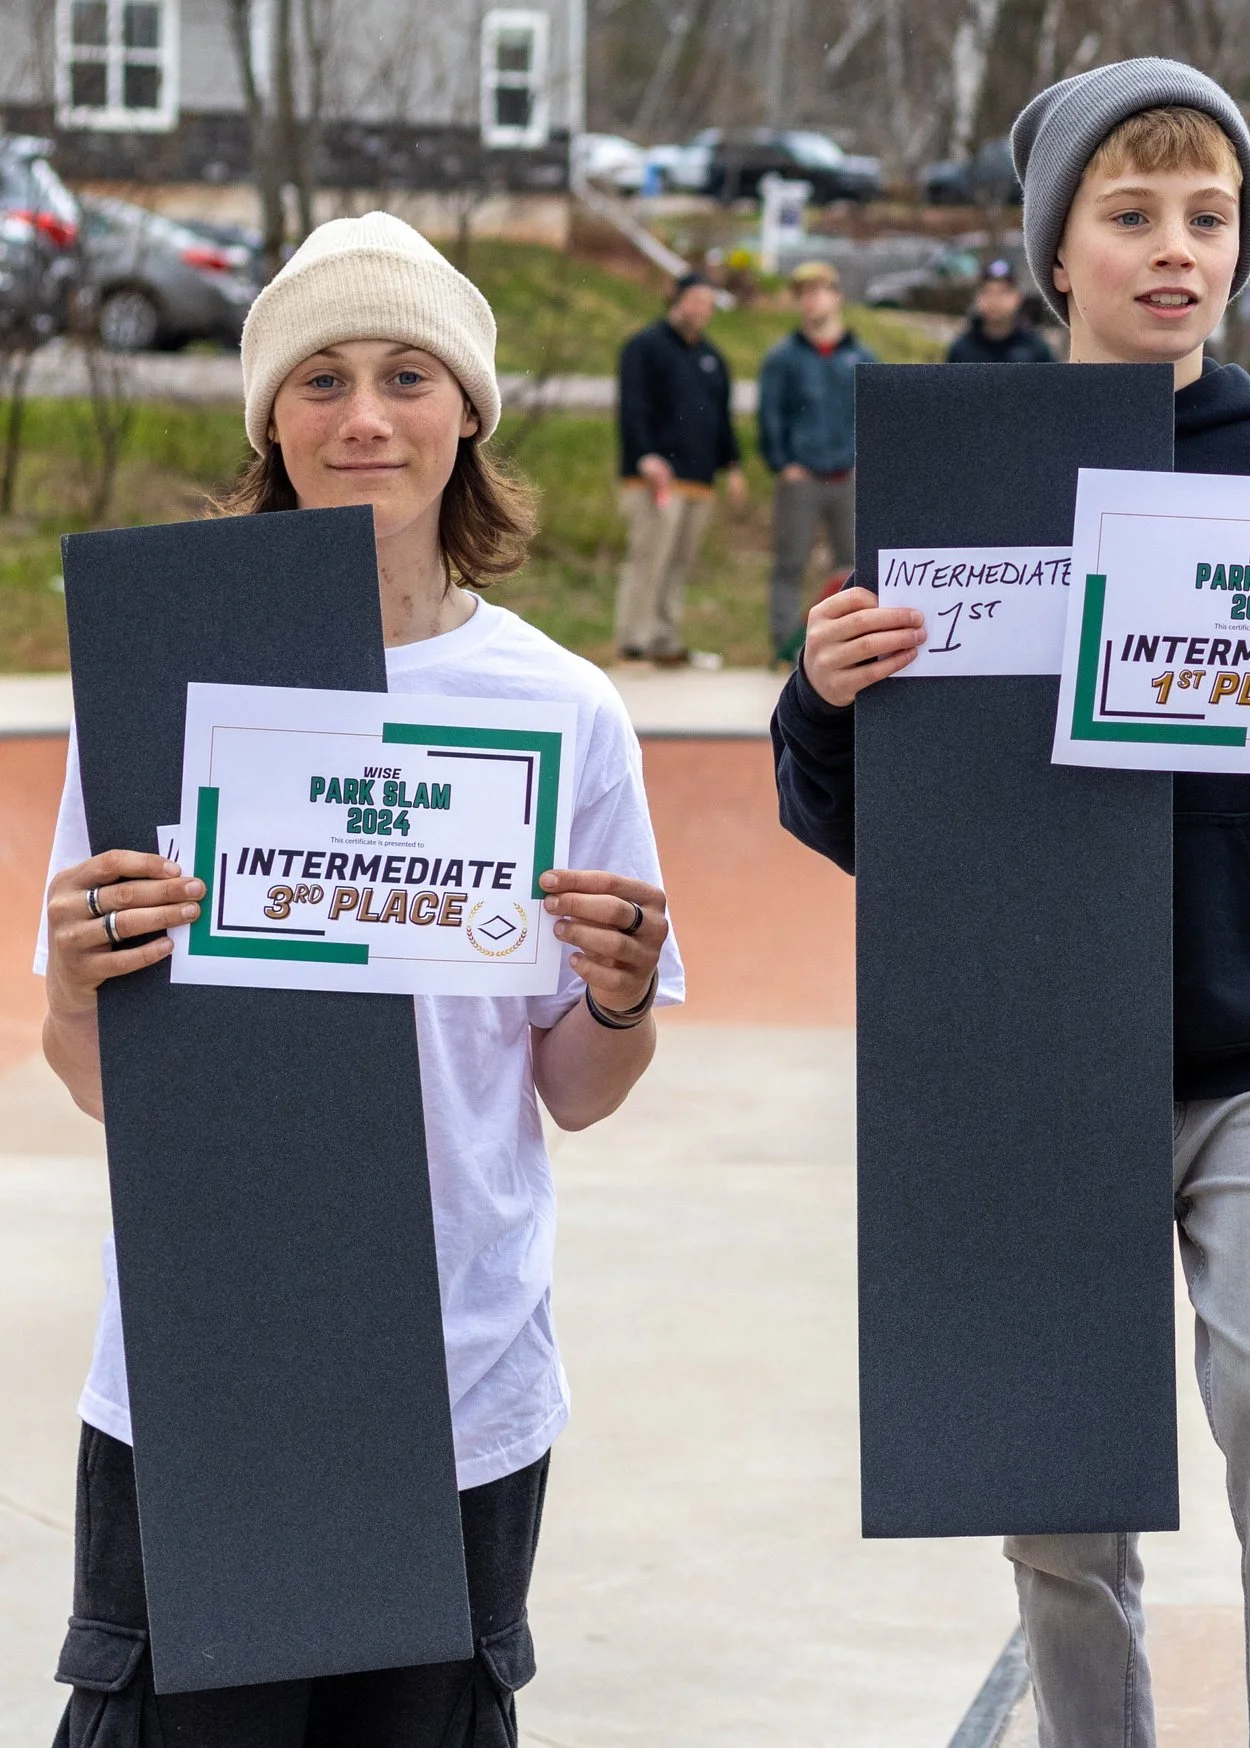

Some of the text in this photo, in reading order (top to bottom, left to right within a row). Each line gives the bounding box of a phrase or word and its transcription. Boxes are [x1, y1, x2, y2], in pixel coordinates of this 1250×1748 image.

[885, 558, 1071, 588] INTERMEDIATE
[364, 767, 402, 779] WISE
[310, 776, 451, 810] PARK SLAM
[347, 807, 410, 836] 2024
[345, 838, 376, 846] certificate
[384, 840, 416, 848] presented
[236, 847, 517, 889] INTERMEDIATE
[328, 886, 468, 927] PLACE
